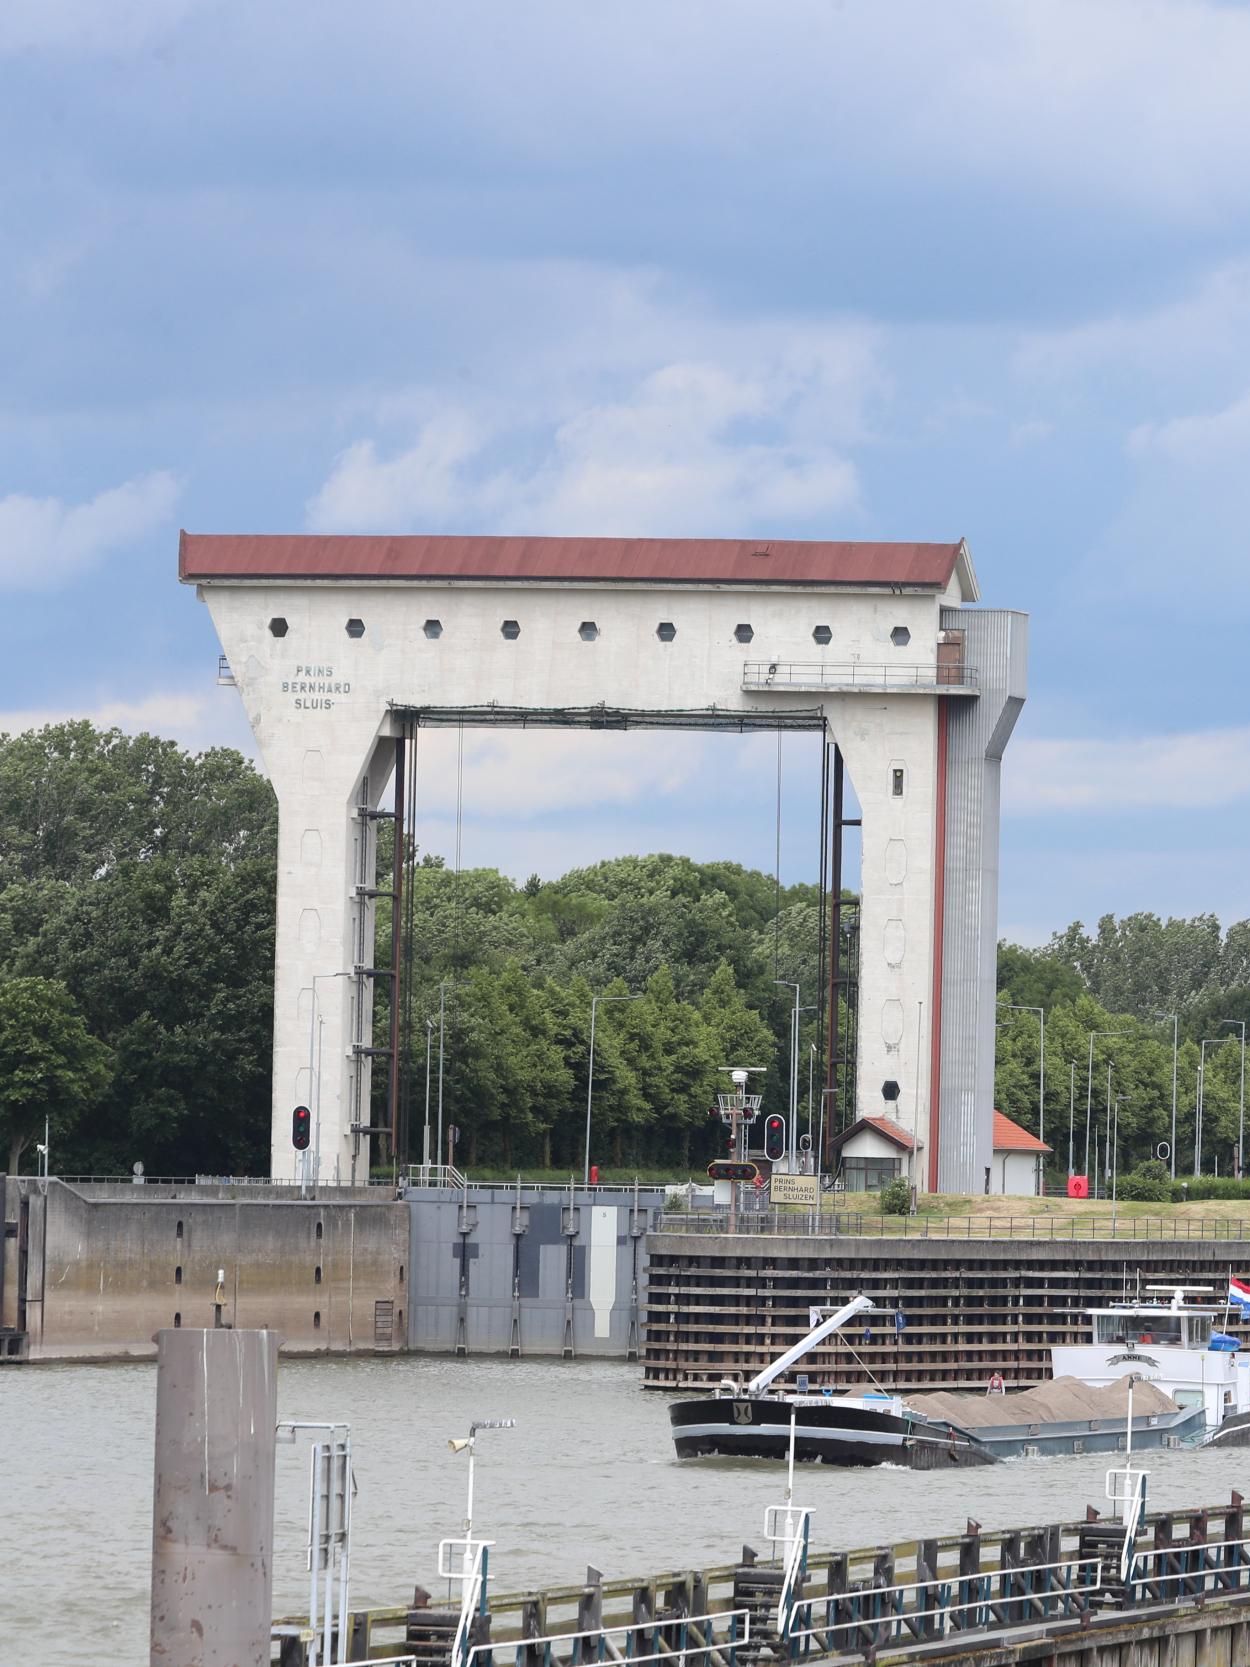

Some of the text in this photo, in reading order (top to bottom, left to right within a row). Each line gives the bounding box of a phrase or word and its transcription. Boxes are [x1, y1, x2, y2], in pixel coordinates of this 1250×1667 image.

[295, 665, 334, 677] PRINS
[281, 681, 351, 694] BERNHARD
[294, 698, 332, 710] SLUIS
[773, 1177, 796, 1185] PRINS
[773, 1185, 815, 1194] BERNHARD
[783, 1193, 815, 1201] SLUIZEN
